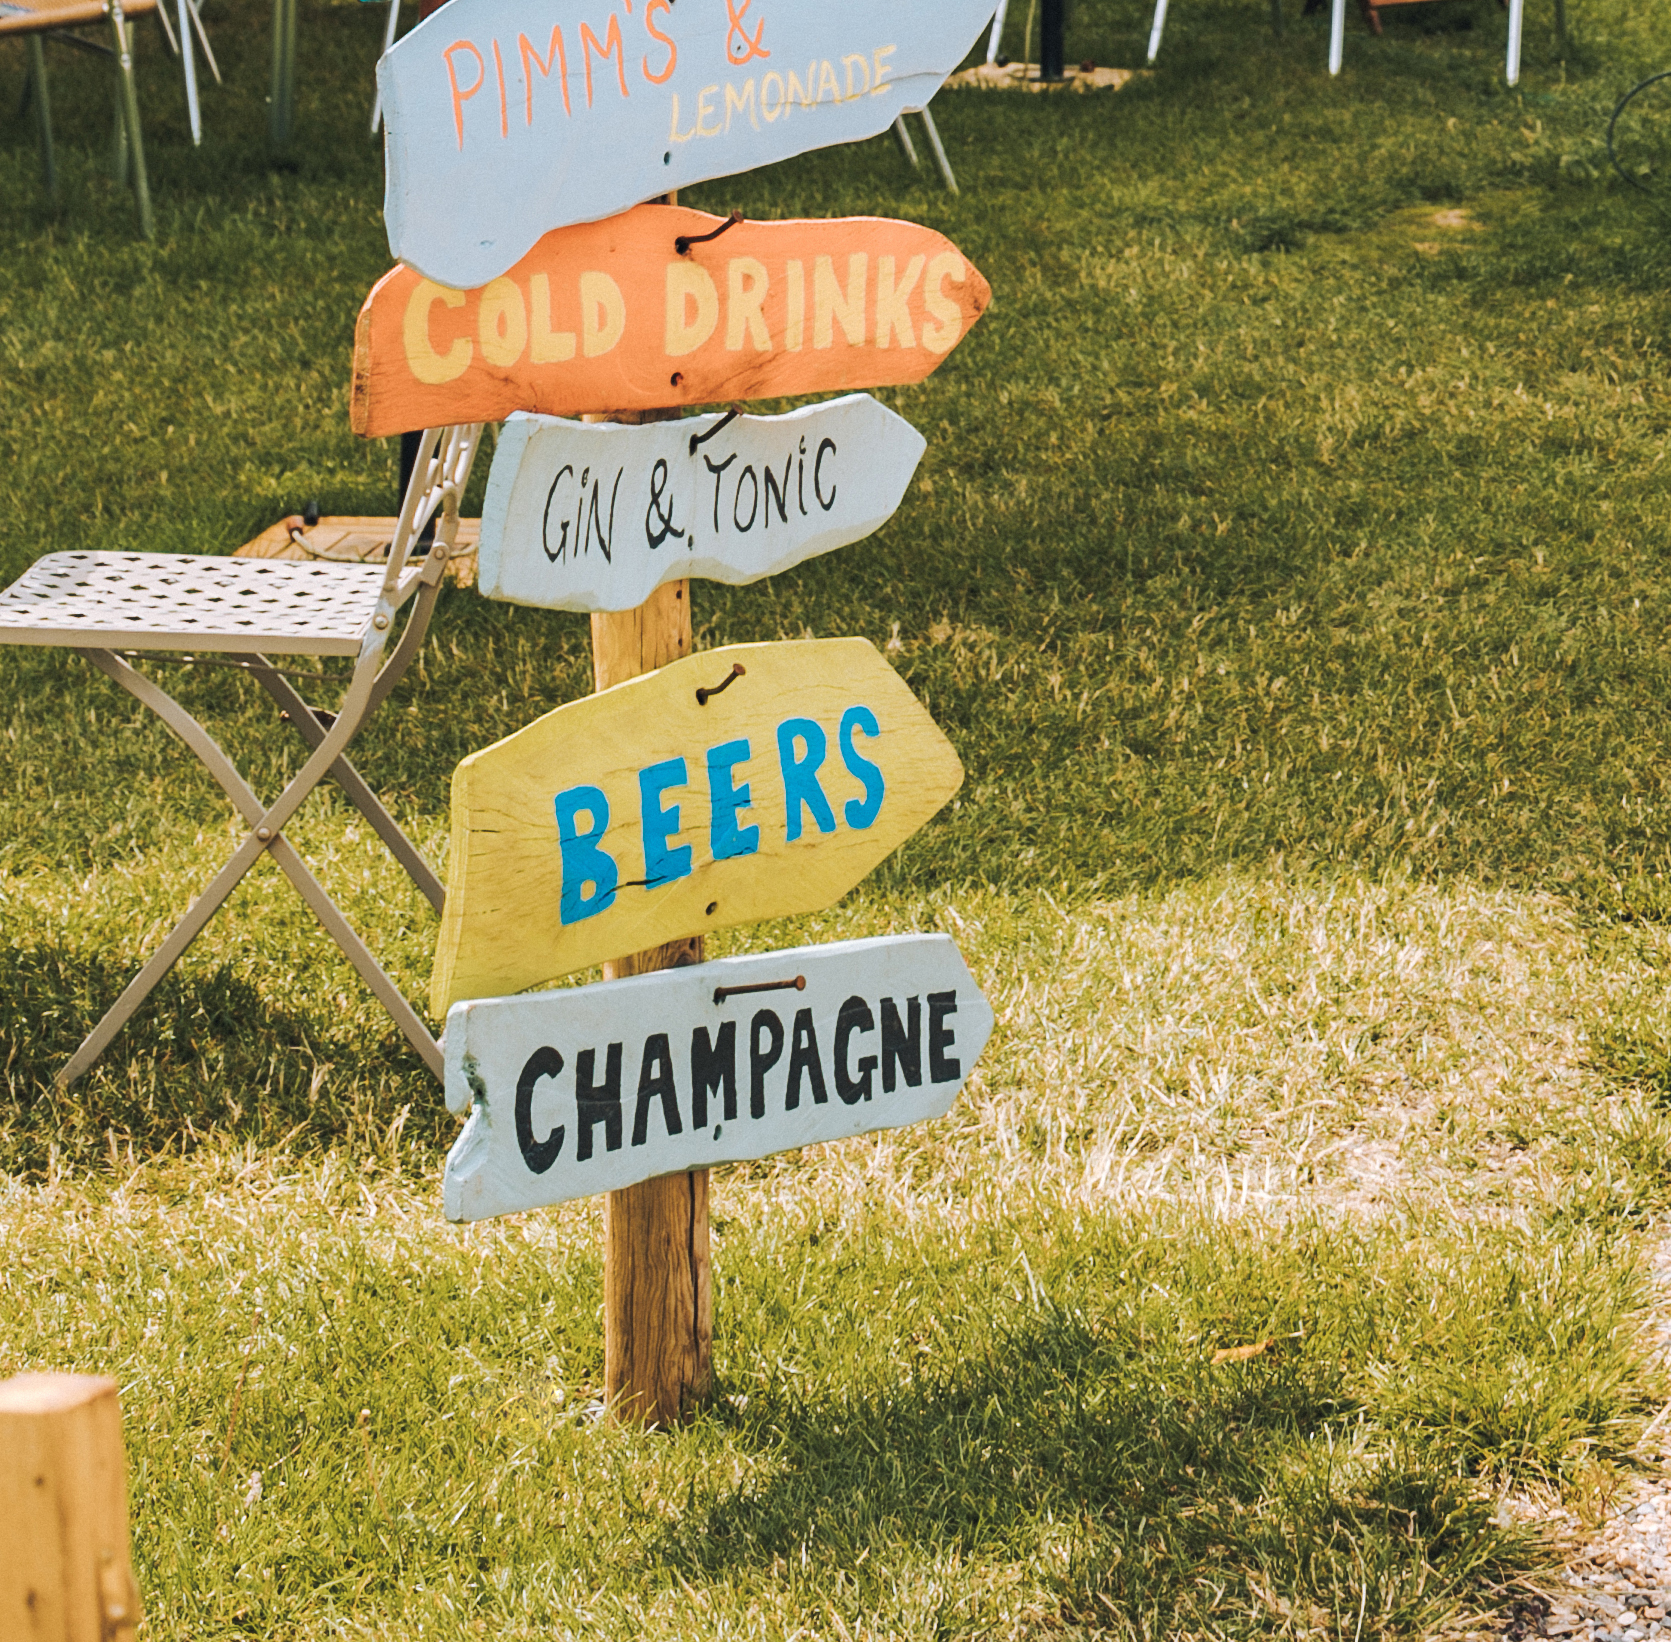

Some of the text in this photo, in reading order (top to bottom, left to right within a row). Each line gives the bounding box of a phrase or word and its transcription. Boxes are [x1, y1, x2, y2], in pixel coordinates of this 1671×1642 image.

[669, 44, 898, 144] LEMONADE
[402, 251, 967, 385] COLD DRINKS
[646, 458, 685, 550] &
[552, 703, 887, 928] BEERS
[513, 988, 963, 1175] CHAMPAGNE
